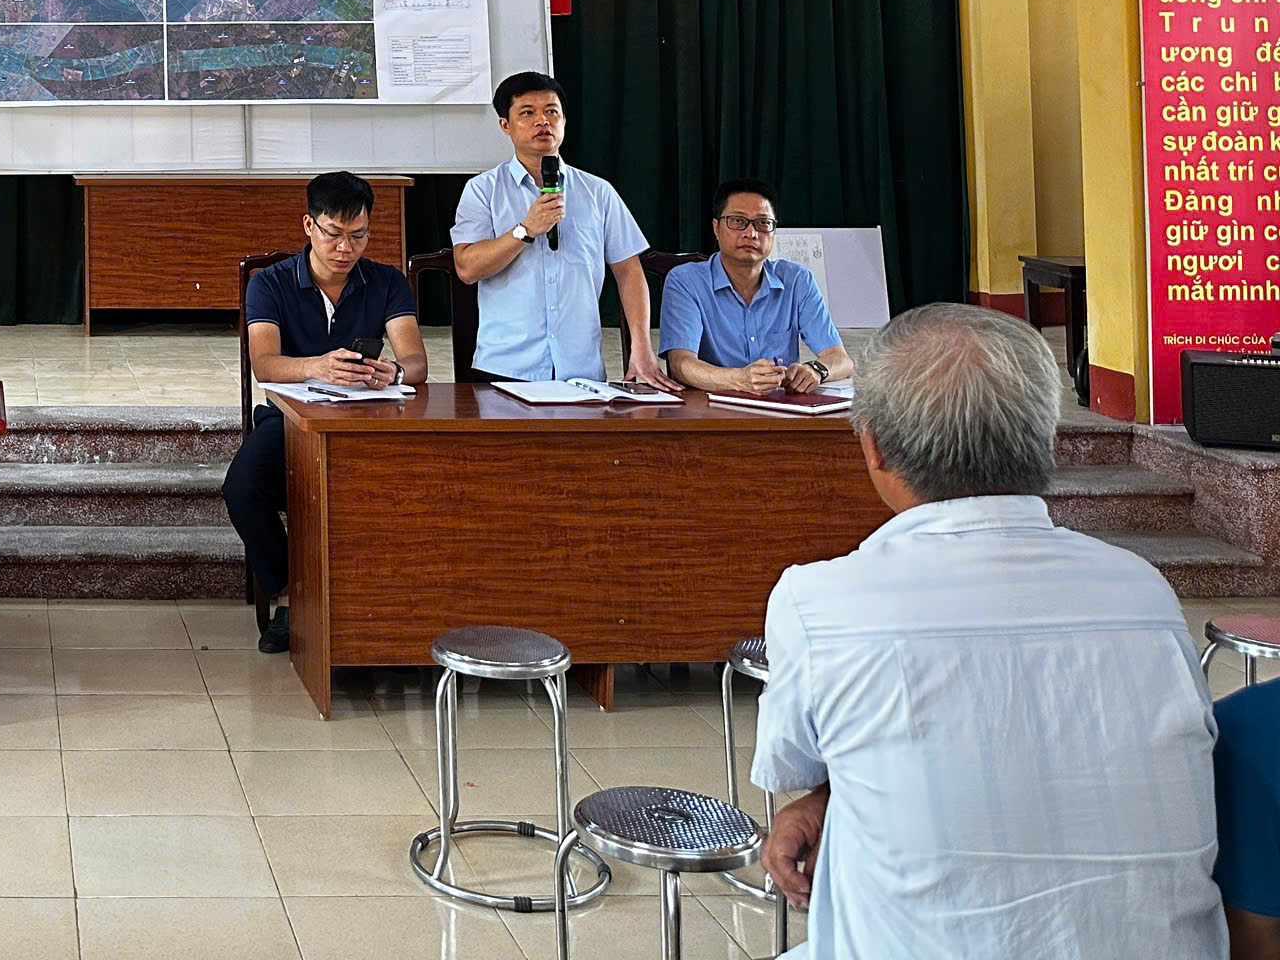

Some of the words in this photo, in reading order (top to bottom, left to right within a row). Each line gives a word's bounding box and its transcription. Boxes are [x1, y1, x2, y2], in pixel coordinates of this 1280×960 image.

[1160, 46, 1233, 68] ương
[1161, 70, 1205, 93] các
[1220, 70, 1258, 93] chi
[1161, 95, 1207, 122] cần
[1215, 100, 1259, 128] giữ
[1162, 135, 1198, 157] sự
[1201, 129, 1264, 152] đoàn
[1164, 154, 1220, 182] nhất
[1227, 159, 1255, 182] trí
[1263, 165, 1280, 182] c
[1163, 188, 1233, 217] Đảng
[1165, 219, 1209, 247] giữ
[1216, 219, 1255, 247] gìn
[1263, 224, 1280, 242] c
[1167, 279, 1215, 302] mắt
[1218, 279, 1280, 302] mình
[1162, 333, 1193, 345] TRÍCH
[1194, 335, 1207, 345] DI
[1208, 333, 1241, 346] CHÚC
[1242, 332, 1267, 345] CỦA
